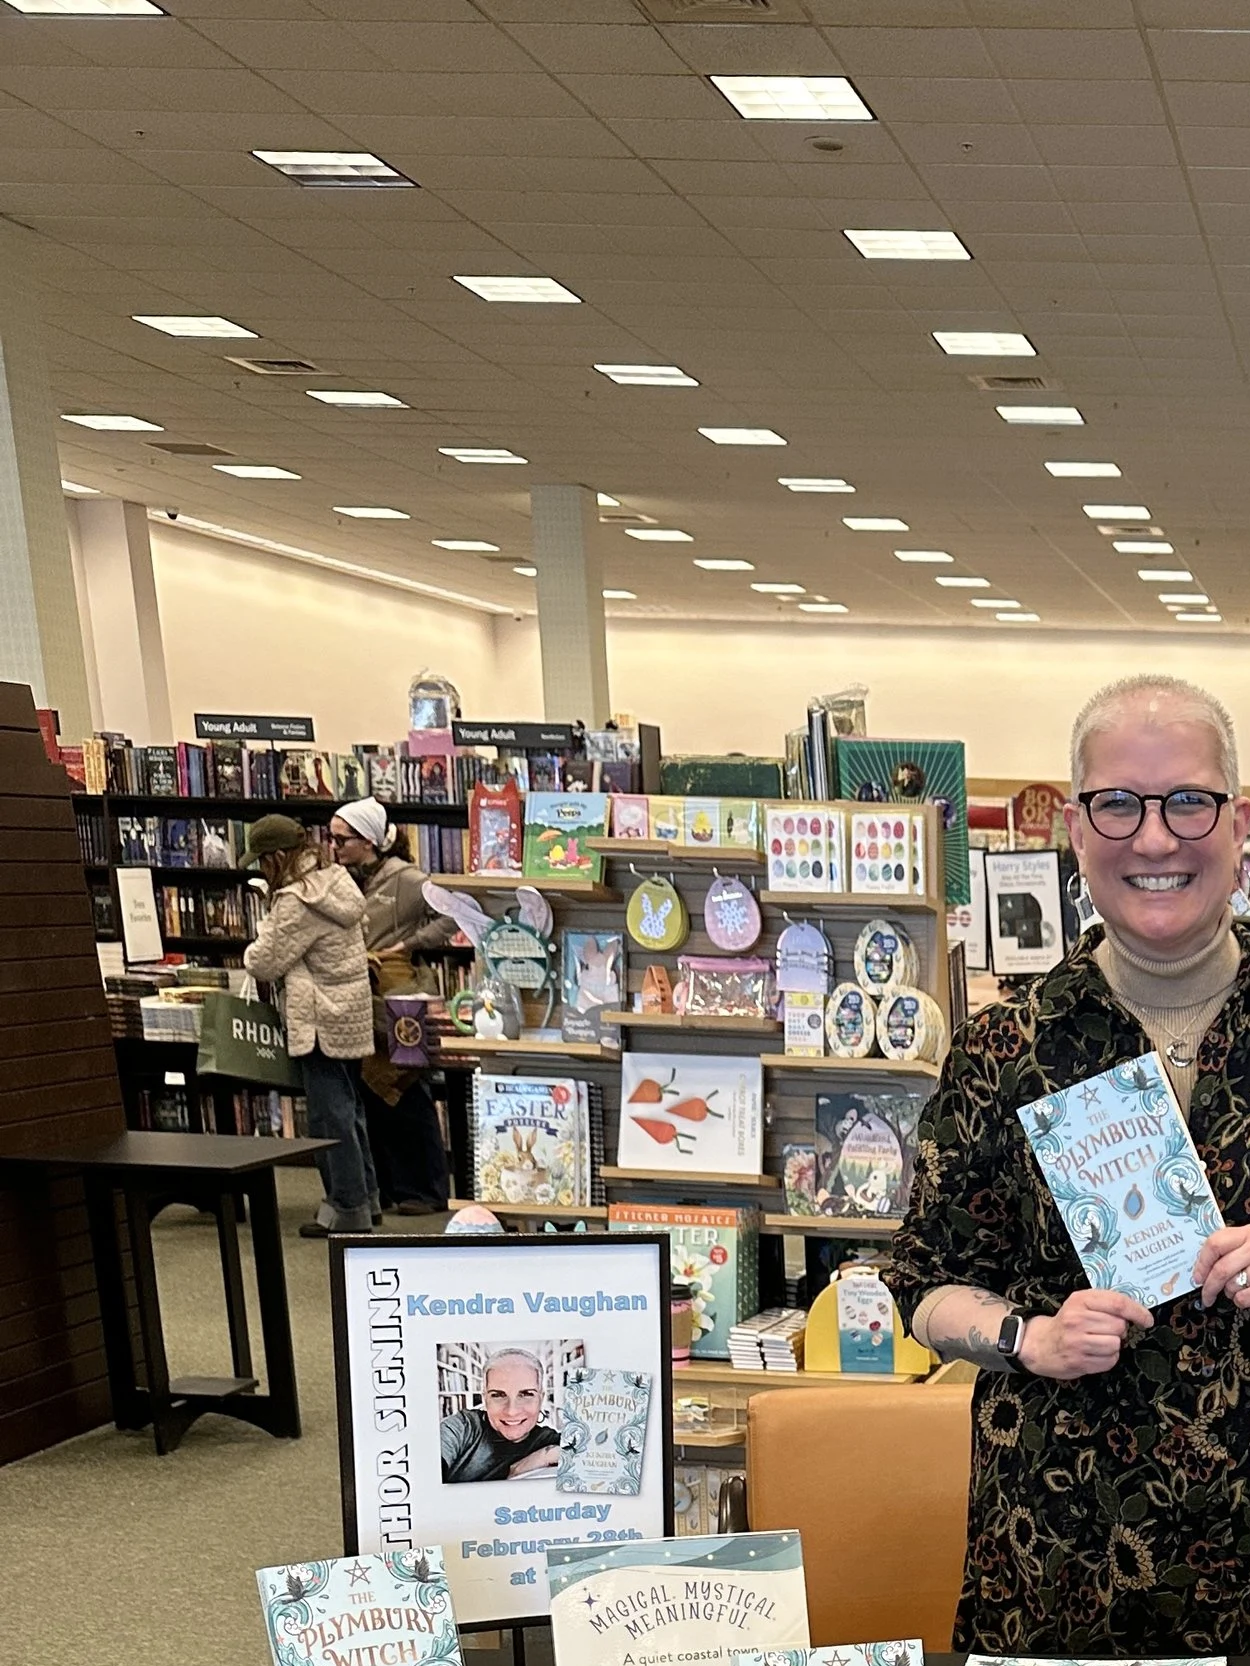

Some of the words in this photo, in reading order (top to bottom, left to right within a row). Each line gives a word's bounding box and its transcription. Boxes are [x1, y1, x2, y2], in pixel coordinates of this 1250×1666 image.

[202, 720, 231, 734] Young
[233, 722, 257, 733] Adult
[459, 727, 489, 741] Young
[491, 728, 516, 741] Adult
[993, 860, 1020, 876] Harry
[1022, 860, 1051, 875] Styles
[232, 1018, 285, 1048] RHON
[485, 1098, 569, 1120] EASTER
[1086, 1112, 1110, 1126] THE
[1055, 1114, 1166, 1181] PLYMBURY
[1079, 1144, 1158, 1189] WITCH
[616, 1211, 669, 1222] STICKER
[675, 1213, 731, 1225] MOSAICS
[1124, 1219, 1175, 1248] KENDRA
[1124, 1231, 1184, 1263] VAUGHAN
[407, 1292, 515, 1317] Kendra
[522, 1290, 648, 1317] Vaughan
[366, 1268, 408, 1433] SIGNING
[574, 1394, 639, 1413] PLYMBURY
[581, 1409, 627, 1423] WITCH
[377, 1443, 413, 1549] THOR
[494, 1502, 612, 1525] Saturday
[510, 1566, 537, 1586] at
[349, 1591, 376, 1604] THE
[298, 1607, 438, 1657] PLYMBURY
[624, 1602, 751, 1640] MEANINGFUL.
[623, 1653, 635, 1666] A
[677, 1646, 723, 1662] coastal
